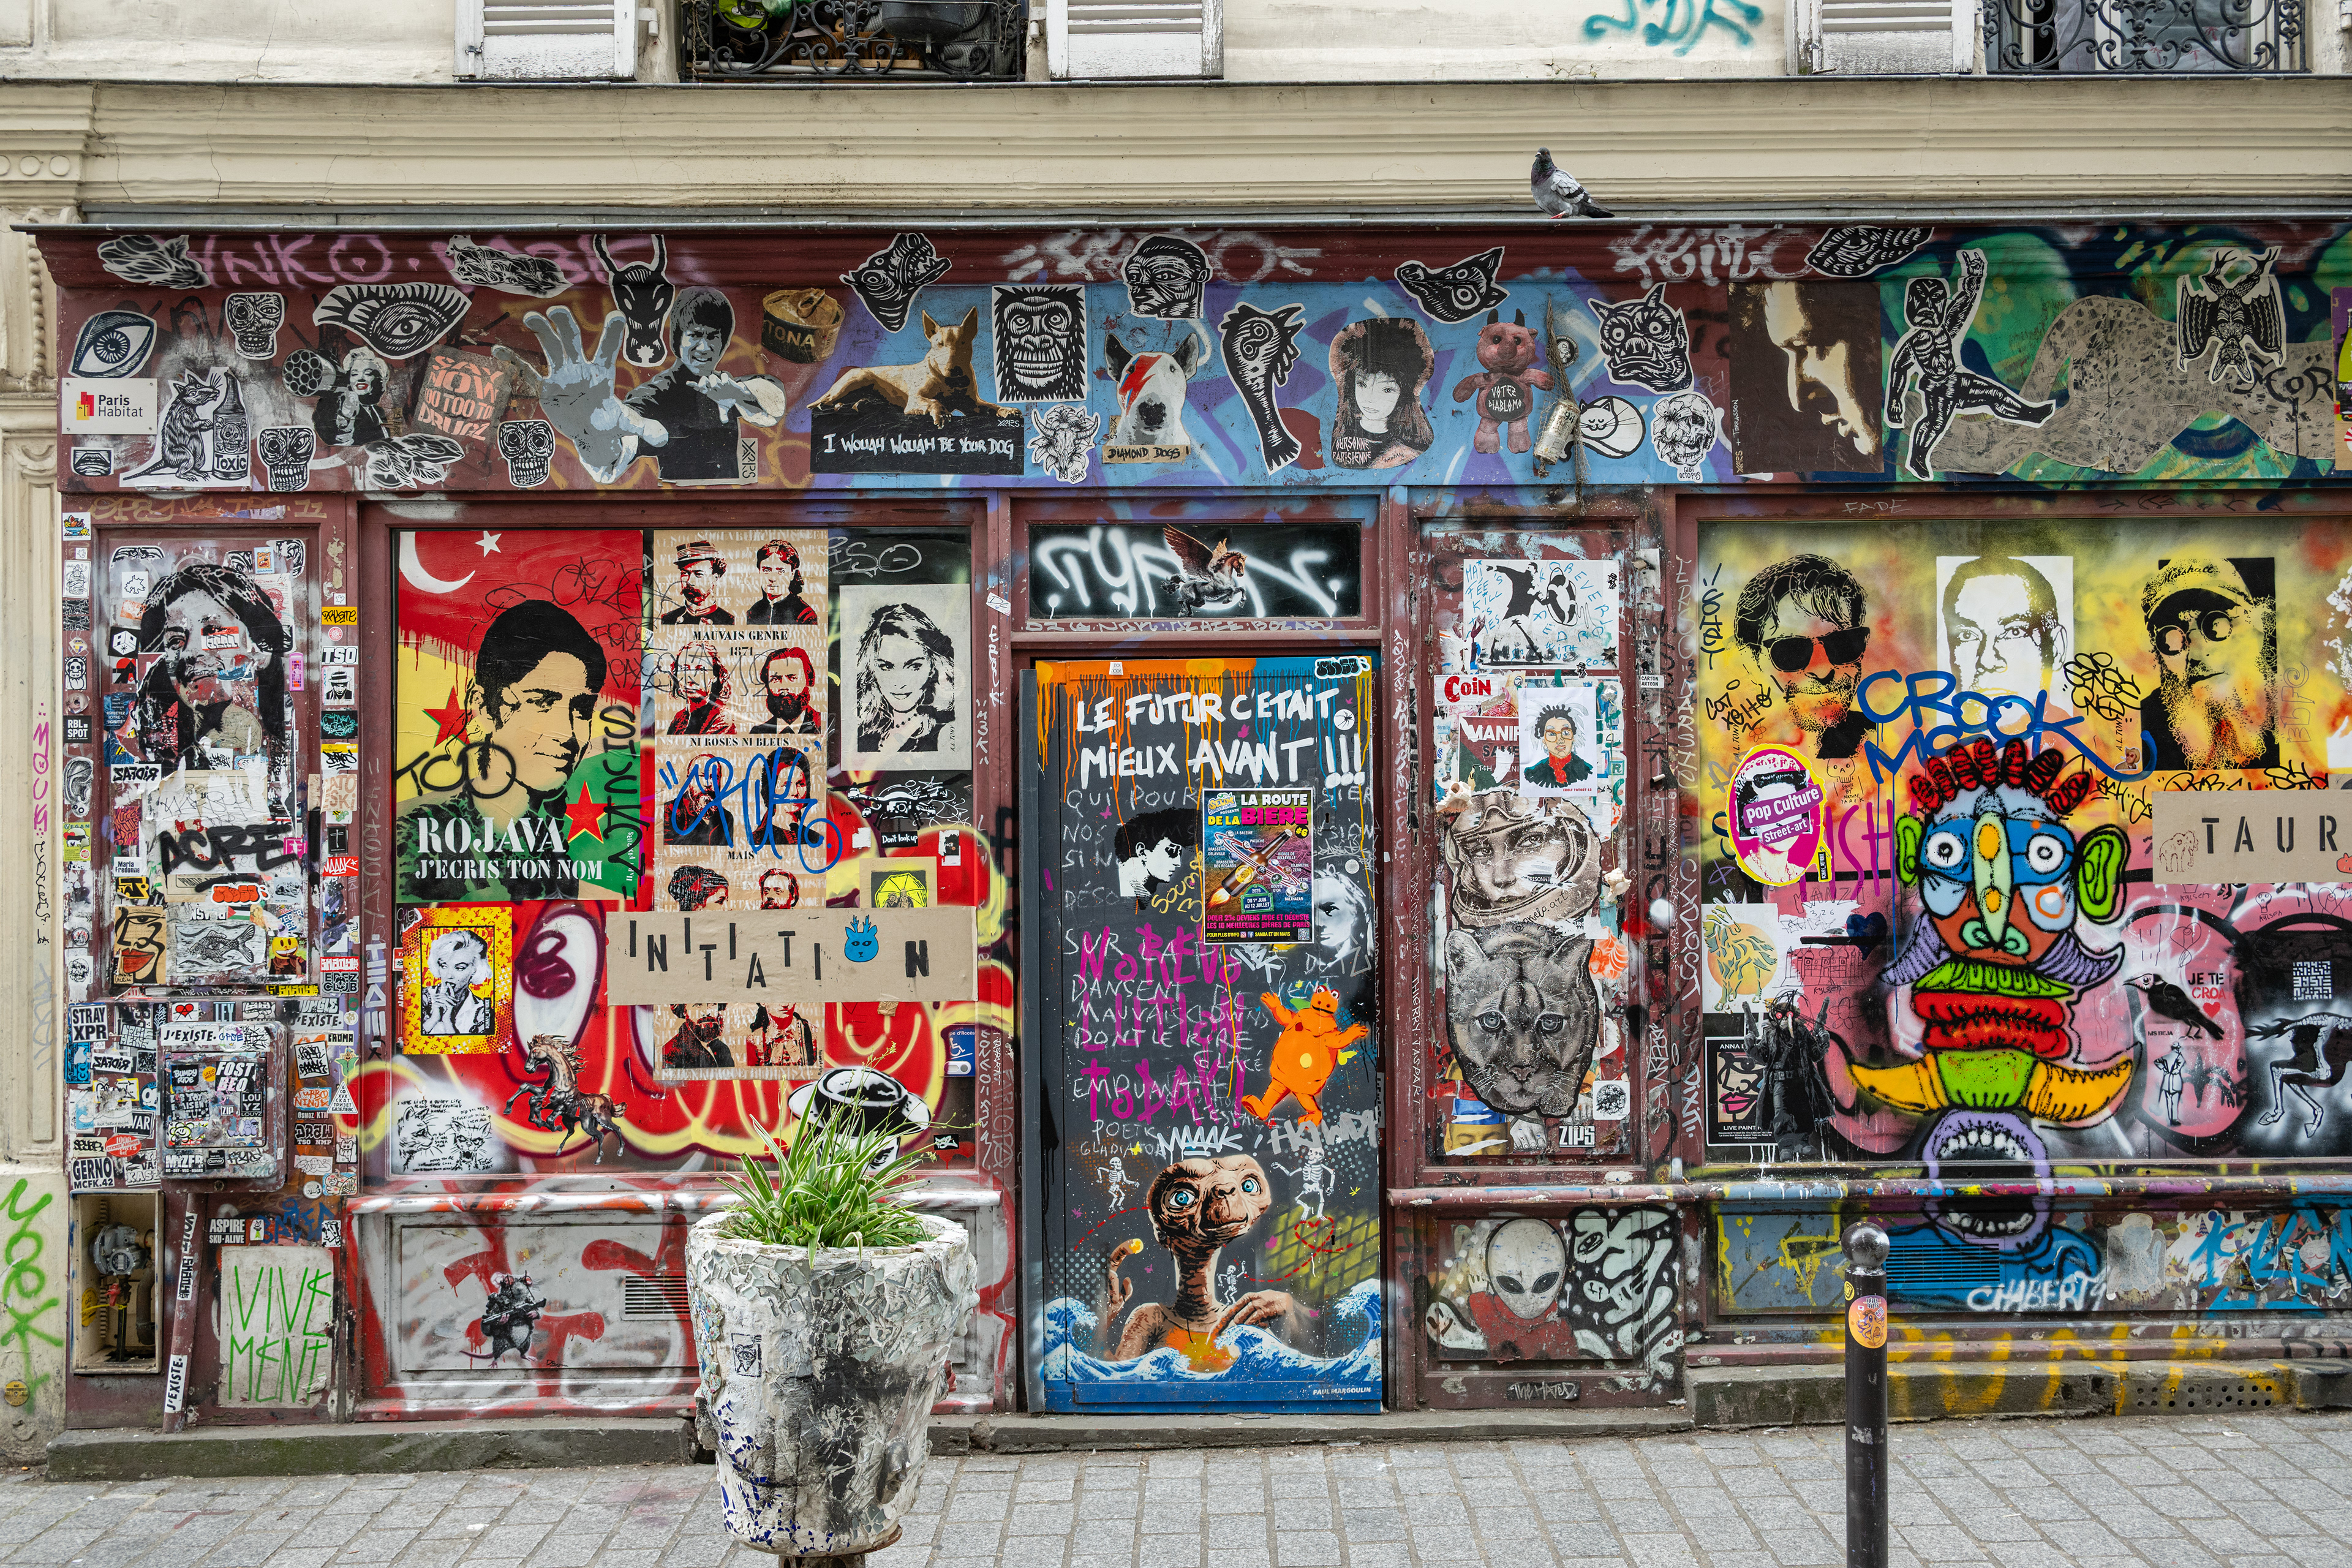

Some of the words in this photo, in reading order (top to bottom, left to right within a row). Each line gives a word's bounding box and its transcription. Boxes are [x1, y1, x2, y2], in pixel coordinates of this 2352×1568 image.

[1491, 383, 1517, 398] VOTEZ
[99, 394, 130, 406] Paris
[1488, 399, 1522, 411] DIABLOMO
[99, 405, 143, 418] Habitat
[824, 434, 836, 453] I
[938, 436, 955, 452] BE
[960, 437, 987, 454] YOUR
[987, 437, 1014, 460] DOG
[215, 454, 246, 472] Toxic
[1333, 450, 1371, 462] PARISIENNE
[2161, 564, 2214, 584] Marshall
[693, 630, 745, 641] MAUVAIS
[748, 630, 788, 640] GENRE
[323, 647, 357, 664] TSO
[729, 646, 755, 656] 1871
[1077, 698, 1115, 732] LE
[1125, 688, 1226, 726] FUTUR
[67, 729, 88, 737] SPOT
[690, 738, 702, 747] NI
[705, 738, 736, 747] ROSES
[741, 738, 753, 747] NI
[755, 738, 789, 747] BLEUS
[1188, 731, 1314, 783] AVANT
[1241, 794, 1259, 805] LA
[1262, 794, 1308, 805] ROUTE
[1747, 804, 1771, 823] Pop
[1773, 787, 1820, 815] Culture
[1208, 816, 1223, 825] DE
[1226, 816, 1240, 825] LA
[1242, 807, 1308, 825] BIERE
[417, 817, 565, 854] ROJAVA
[1296, 827, 1308, 837] #6
[1763, 819, 1808, 843] Street-art
[882, 834, 897, 843] Don't
[728, 851, 754, 859] MAIS
[415, 859, 500, 880] J'ECRIS
[508, 859, 550, 880] TON
[557, 859, 602, 880] NOM
[1284, 912, 1310, 921] DÉGUSTE
[2188, 972, 2204, 986] JE
[2208, 972, 2224, 986] TE
[2191, 987, 2226, 999] CROA
[72, 1007, 105, 1023] STRAY
[74, 1025, 107, 1041] XPR
[164, 1030, 216, 1041] J'EXISTE.
[216, 1062, 254, 1077] FOST
[74, 1158, 112, 1180] GERNO
[210, 1219, 244, 1233] ASPIRE
[167, 1358, 183, 1411] J'EXISTE.
[1332, 1386, 1371, 1395] MARGOULIN
